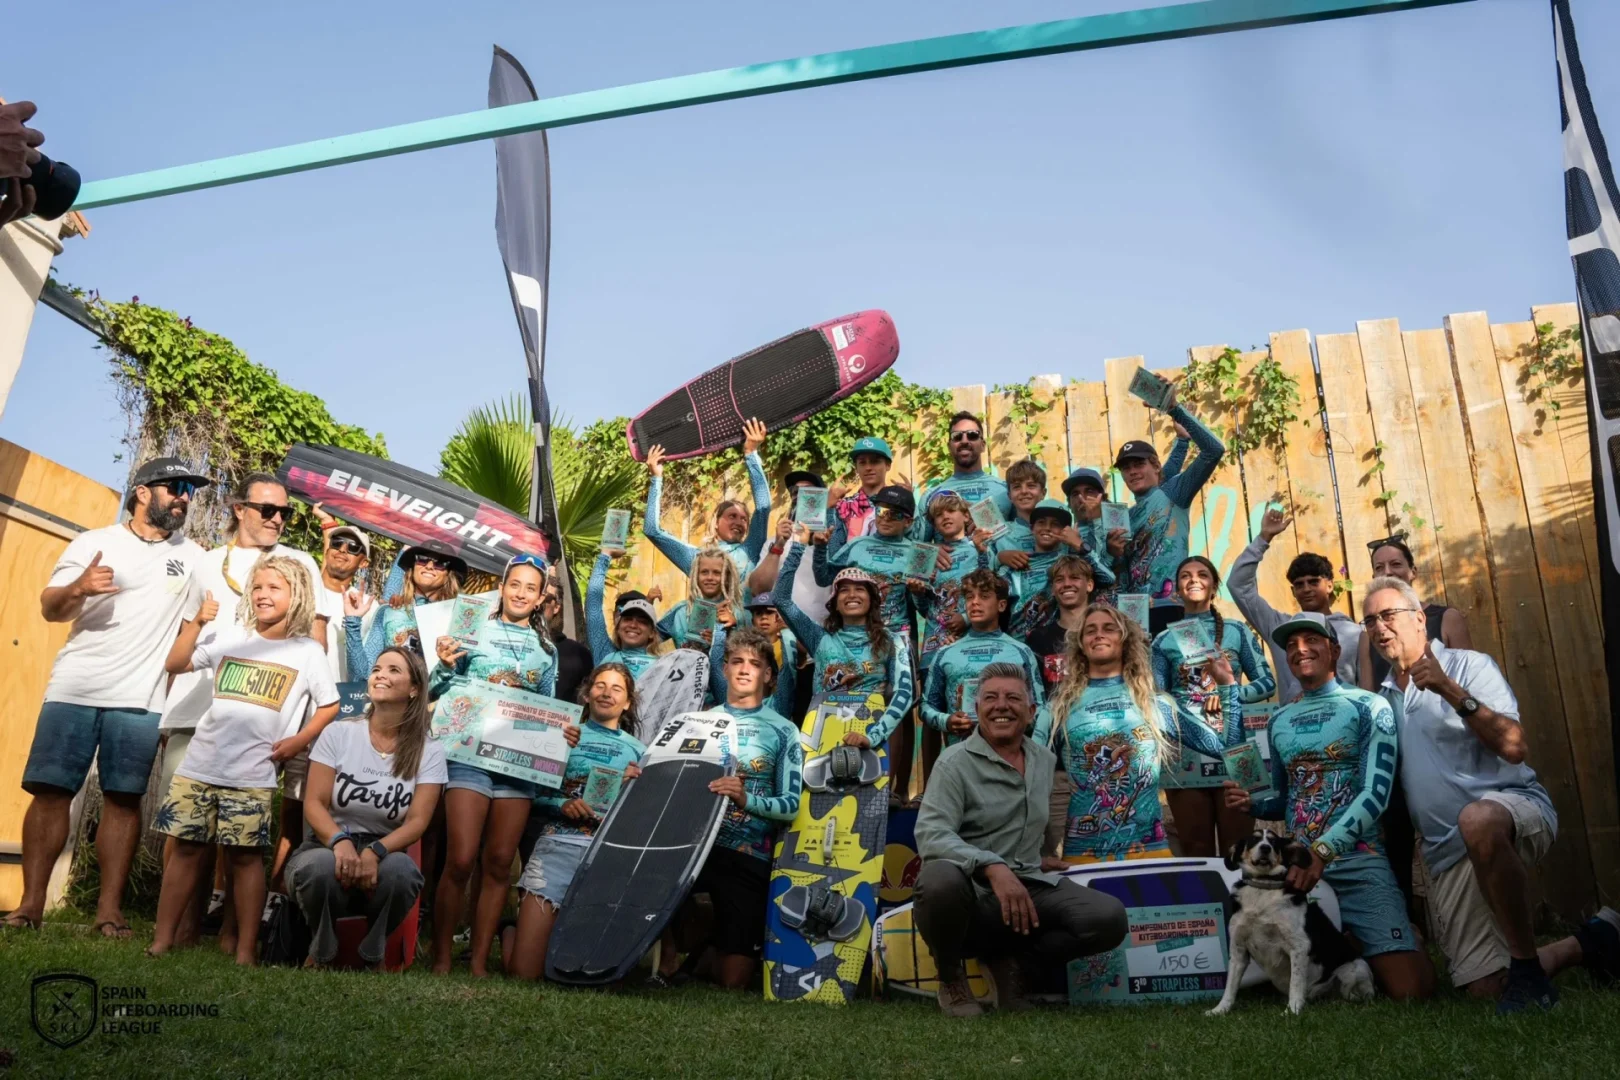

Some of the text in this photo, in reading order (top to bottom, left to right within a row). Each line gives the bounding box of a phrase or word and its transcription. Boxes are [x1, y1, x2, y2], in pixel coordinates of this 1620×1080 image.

[325, 469, 513, 548] ELEVEIGHT
[221, 663, 287, 701] QUIKSILVER
[694, 656, 706, 699] CHIEMSEE
[498, 700, 538, 716] CAMPEONATO
[538, 709, 548, 718] DE
[548, 710, 571, 722] ESPAÑA
[502, 709, 546, 724] KITEBOARDING
[546, 719, 563, 729] 2024
[683, 715, 715, 725] Eleveight
[718, 734, 732, 766] Huelva
[493, 748, 532, 767] STRAPLESS
[533, 759, 560, 775] WOMEN
[336, 772, 413, 820] Tarifa
[1130, 918, 1215, 933] CAMPEONATO DE ESPAÑA
[1139, 929, 1209, 941] KITEBOARDING 2024
[1159, 952, 1210, 972] 150 €
[1152, 977, 1199, 991] STRAPLESS
[1204, 976, 1224, 990] MEN
